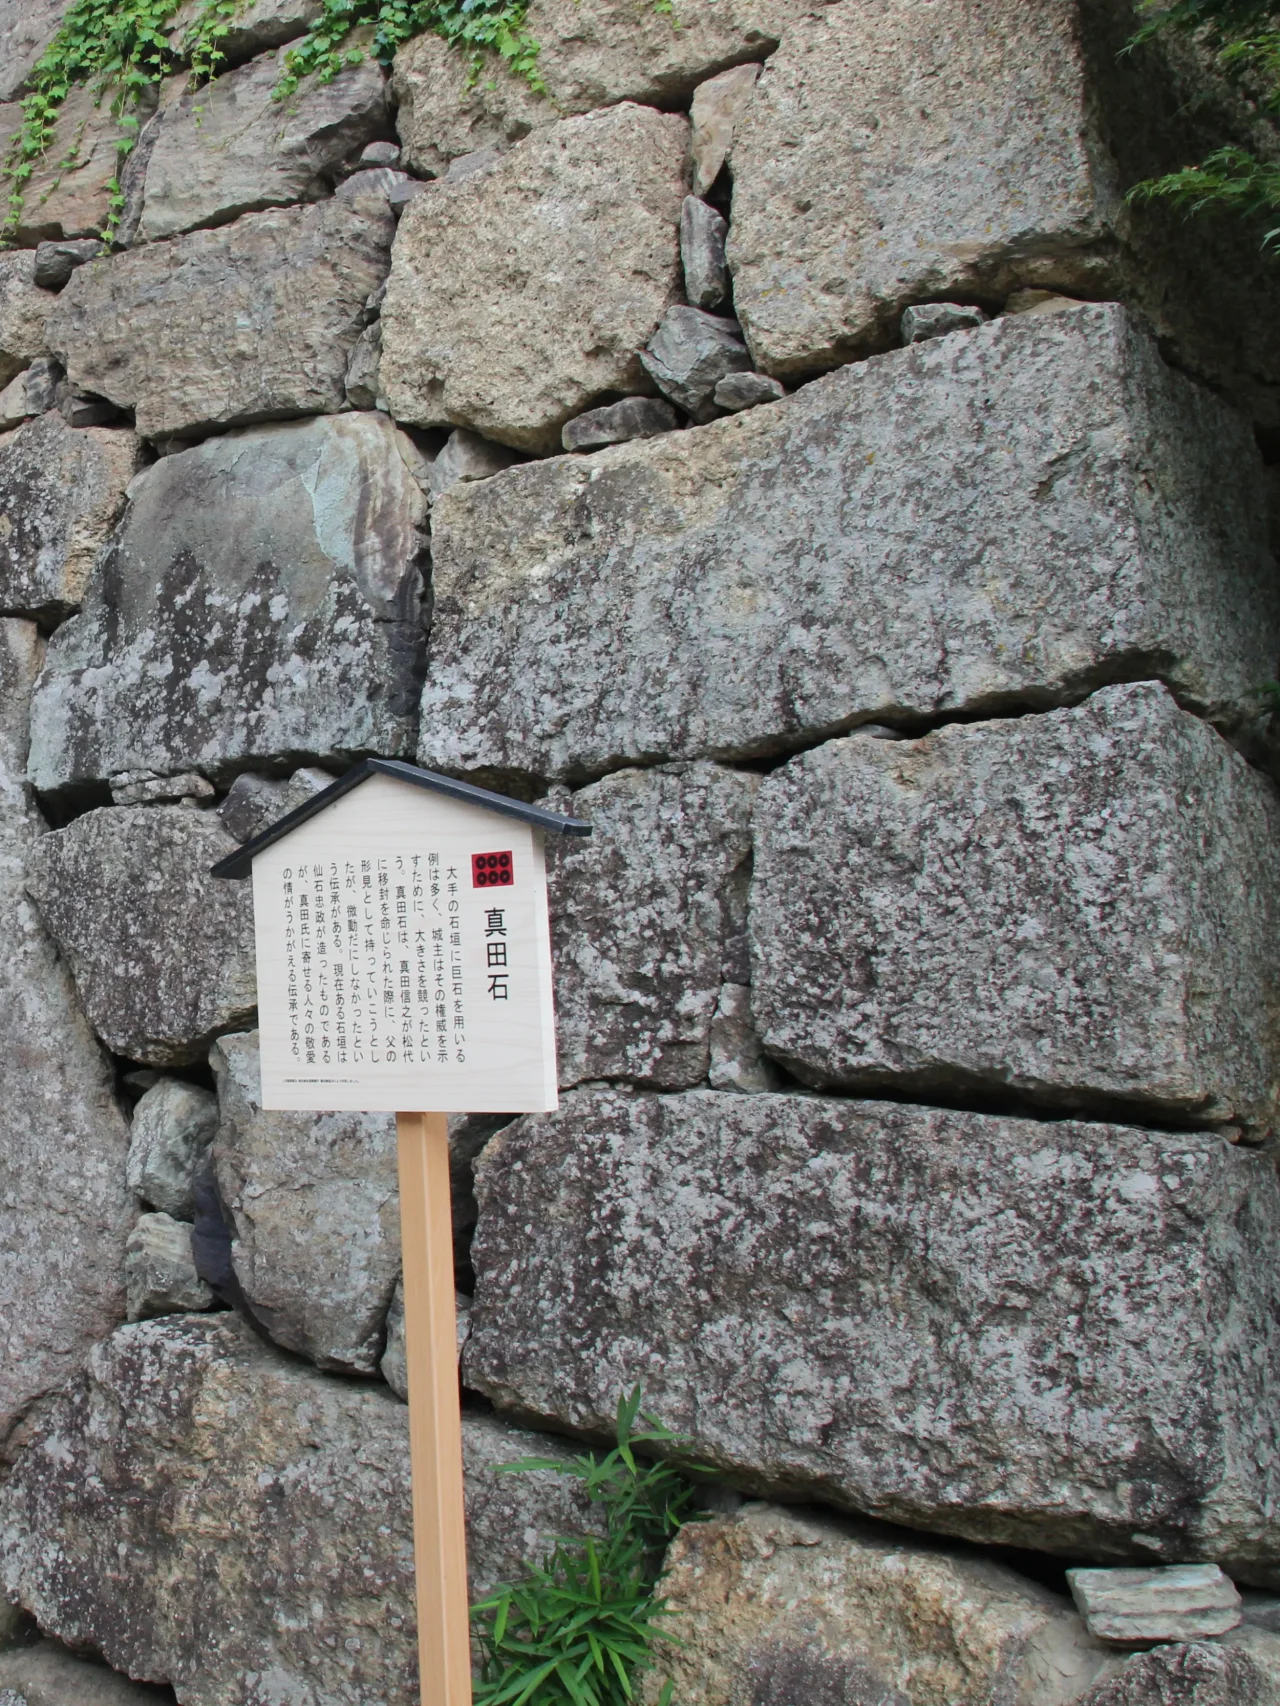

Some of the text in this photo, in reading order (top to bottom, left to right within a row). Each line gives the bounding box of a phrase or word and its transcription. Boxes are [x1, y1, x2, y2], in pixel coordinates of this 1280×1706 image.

[282, 867, 301, 1062] の情がうかがえる伝承である。
[298, 865, 315, 1063] が、真田氏に寄せる人々の敬愛
[313, 865, 330, 1063] 仙石忠政が造ったものである
[329, 863, 347, 1063] う伝承がある。現在ある石垣は
[345, 862, 363, 1062] たが、微動だにしなかったとい
[361, 860, 379, 1063] 形見として持っていこうとし
[378, 859, 396, 1062] に移封を命じられた際に、父の
[396, 856, 413, 1062] う。真田石は、真田信之が松代
[411, 854, 430, 1062] すために、大きさを競ったとい
[428, 853, 448, 1062] 例は多く、城主はその権威を示
[447, 866, 465, 1062] 大手の石垣に巨石を用いる
[484, 907, 509, 1000] 真田石
